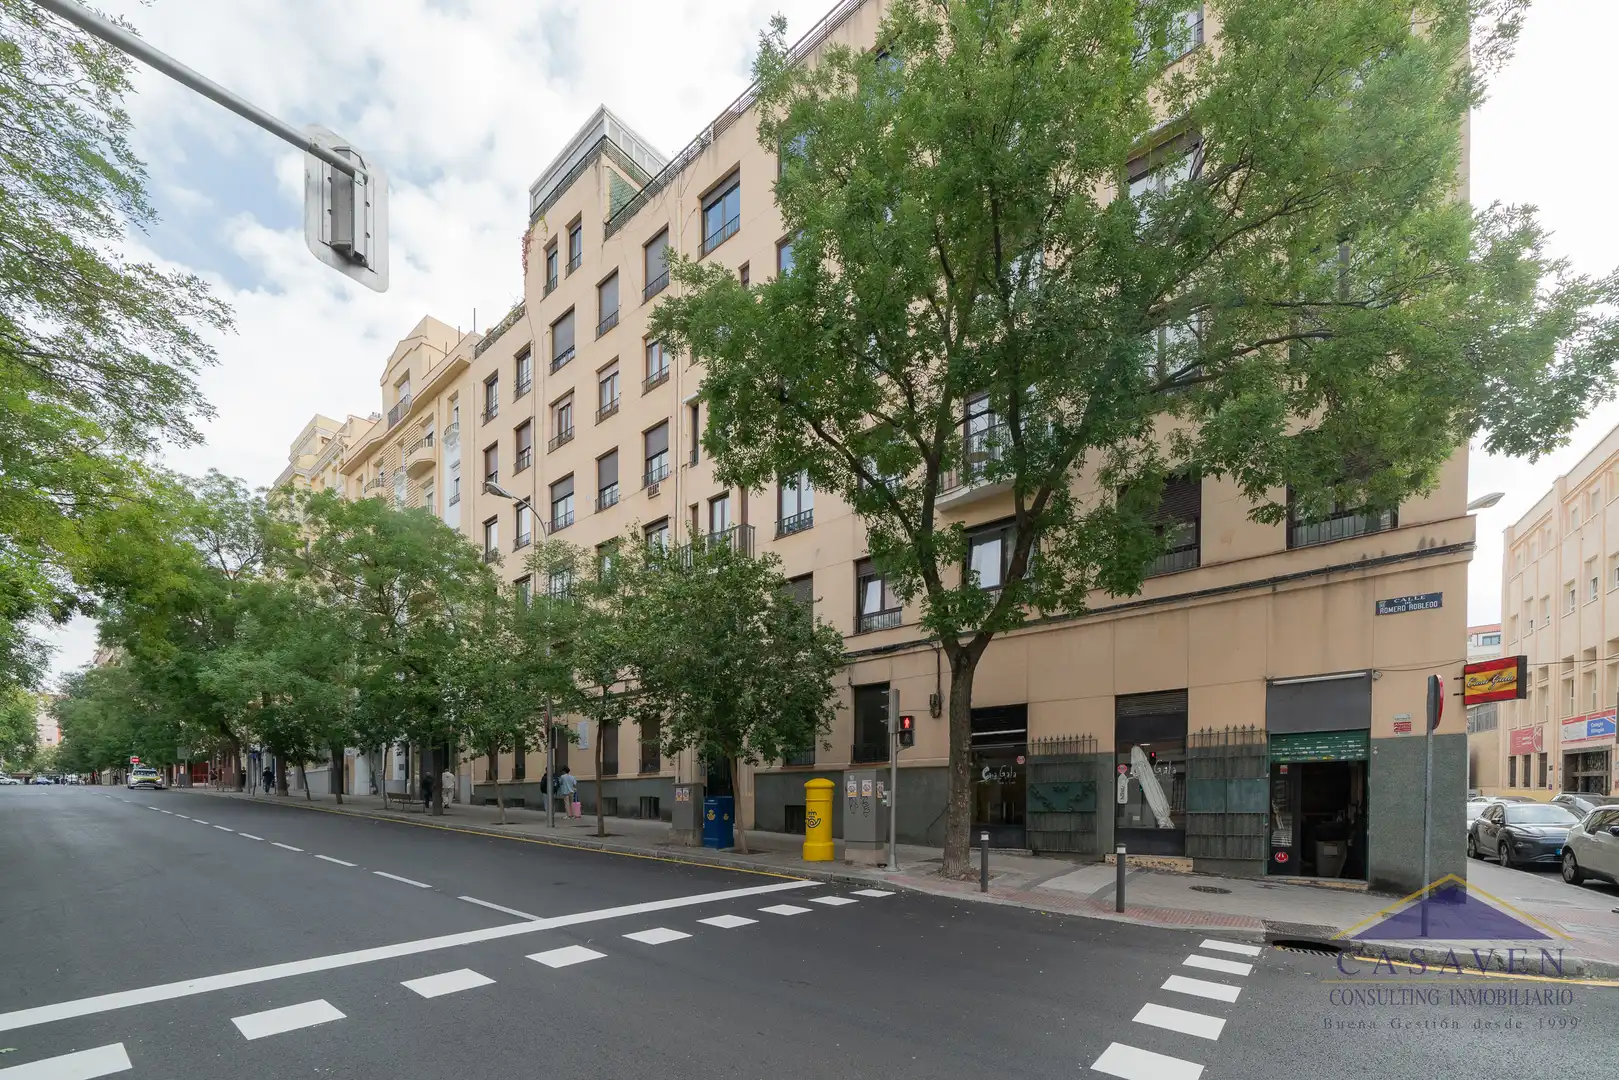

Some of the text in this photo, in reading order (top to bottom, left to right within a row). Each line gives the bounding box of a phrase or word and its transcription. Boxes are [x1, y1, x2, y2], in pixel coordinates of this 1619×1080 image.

[1393, 595, 1426, 603] CALLE
[1379, 600, 1438, 615] ROMERO ROBLEDO
[999, 764, 1017, 778] Gala
[1153, 759, 1177, 776] Gala
